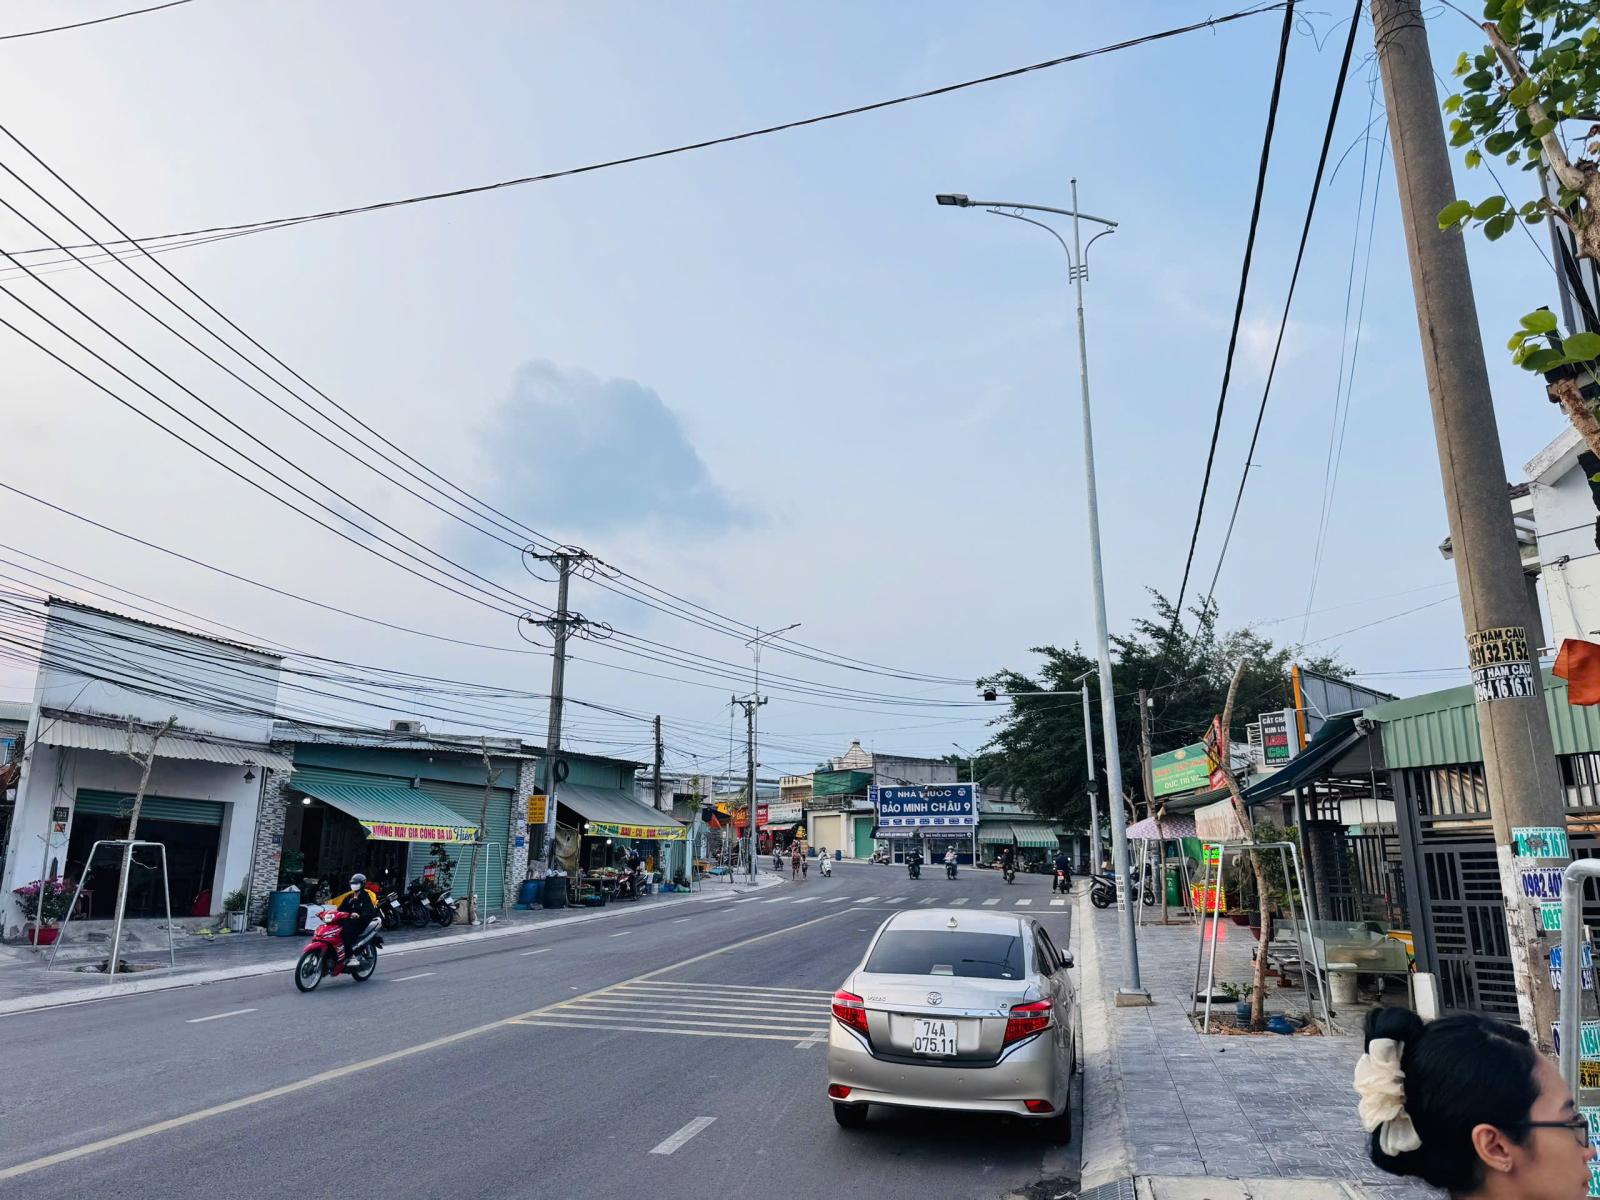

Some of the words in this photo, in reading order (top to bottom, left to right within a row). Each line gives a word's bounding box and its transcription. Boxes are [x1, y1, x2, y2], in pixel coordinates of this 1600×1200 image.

[897, 790, 916, 798] NHÀ
[882, 801, 900, 812] BẢO
[904, 803, 928, 812] MINH
[930, 800, 960, 812] CHÂU
[964, 802, 970, 812] 9
[924, 1022, 946, 1037] 74A
[914, 1036, 954, 1053] 075.11
